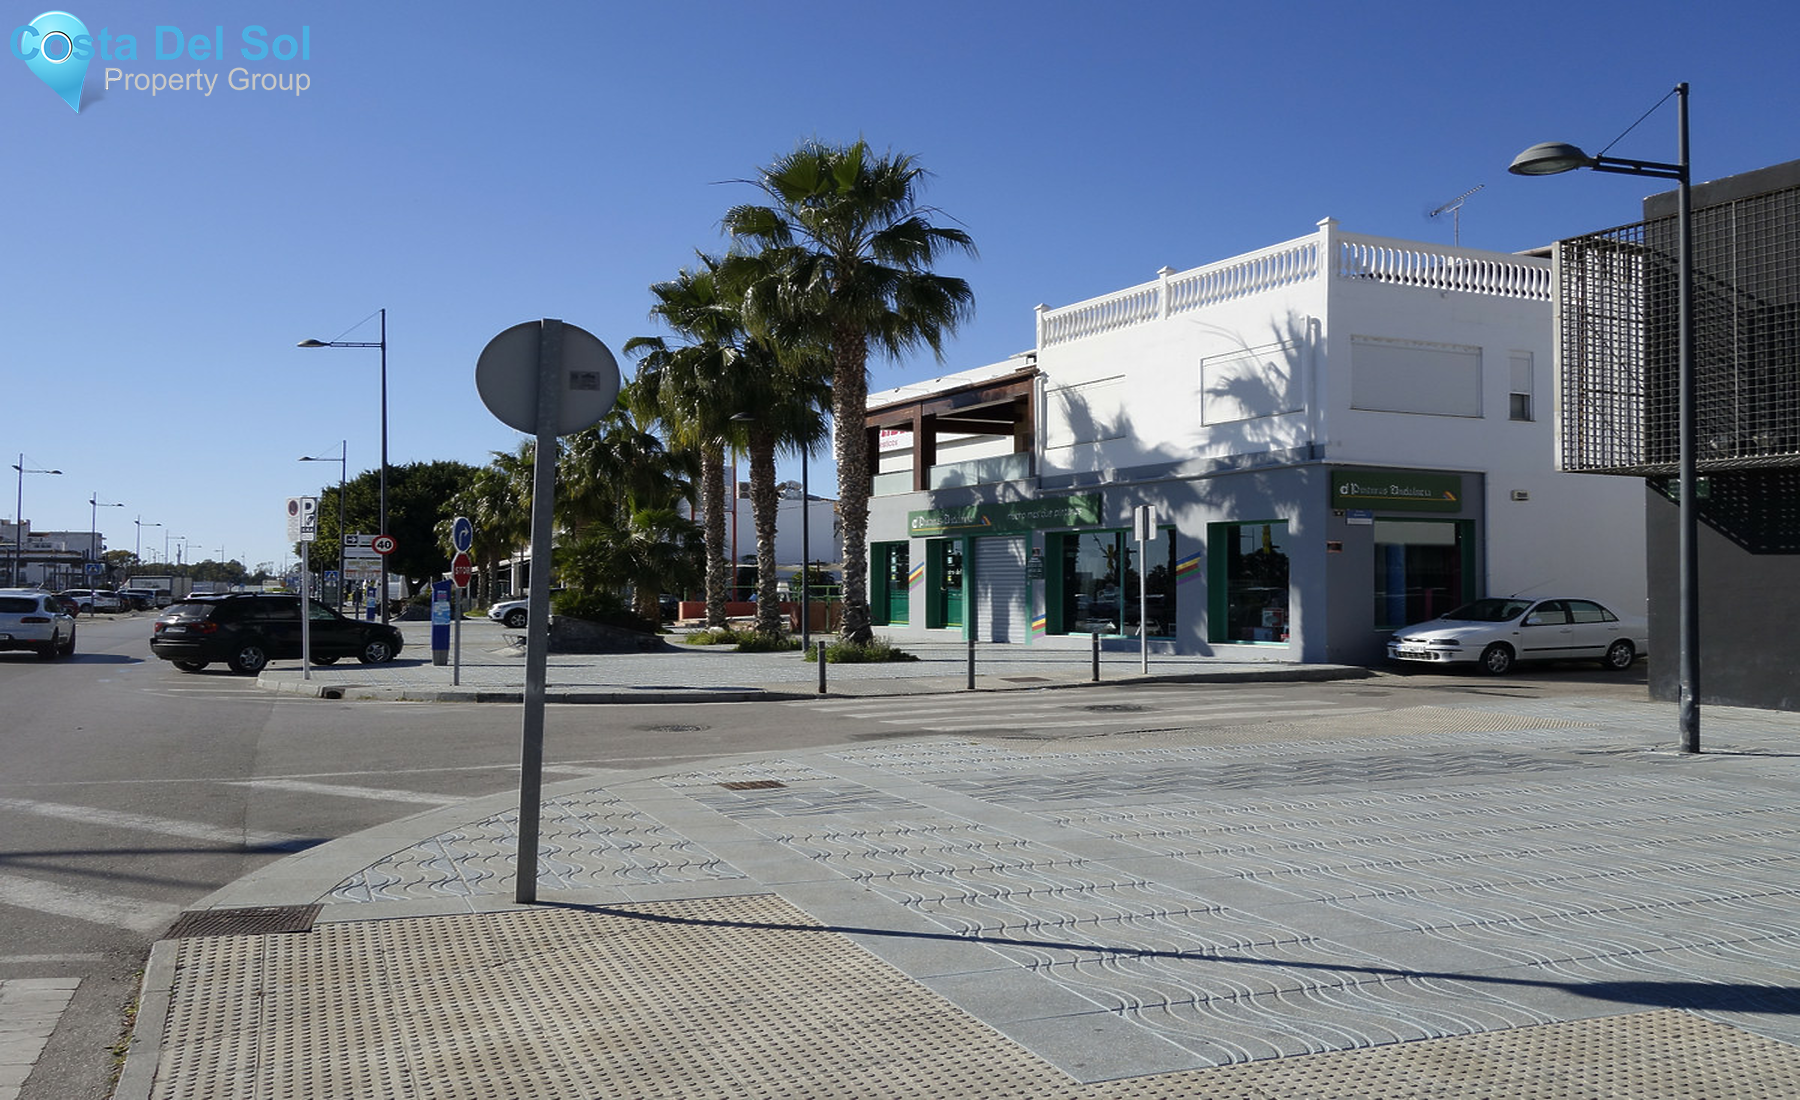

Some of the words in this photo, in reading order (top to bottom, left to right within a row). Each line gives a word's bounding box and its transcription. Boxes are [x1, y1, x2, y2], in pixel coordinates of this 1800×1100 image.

[302, 499, 315, 527] P
[377, 540, 392, 549] 40
[455, 566, 471, 575] STOP
